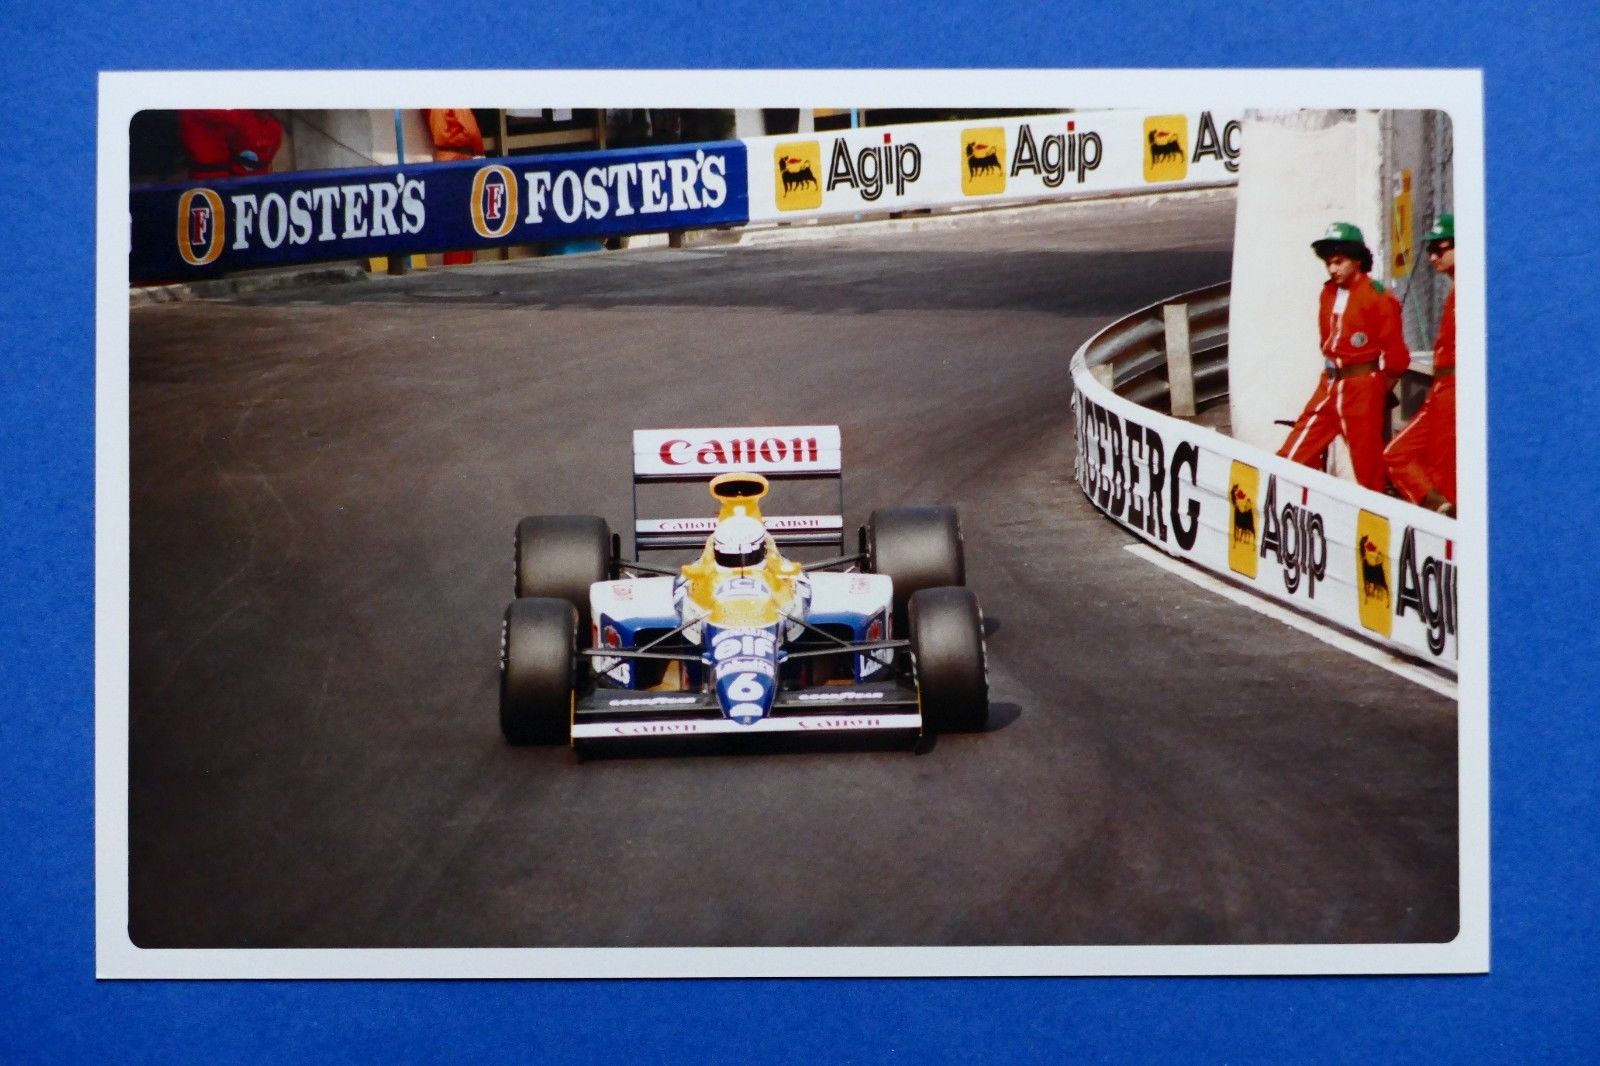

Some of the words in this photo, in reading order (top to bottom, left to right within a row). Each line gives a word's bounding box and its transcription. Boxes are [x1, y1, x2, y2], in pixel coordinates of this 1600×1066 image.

[486, 184, 504, 219] F
[524, 150, 727, 224] FOSTER'S
[826, 133, 922, 201] Agip
[1010, 121, 1103, 187] Agip
[191, 207, 209, 245] F
[231, 173, 426, 250] FOSTER'S
[659, 437, 819, 465] Canon
[1260, 473, 1327, 599] Agip
[1396, 525, 1459, 660] Agi
[727, 672, 765, 702] 6
